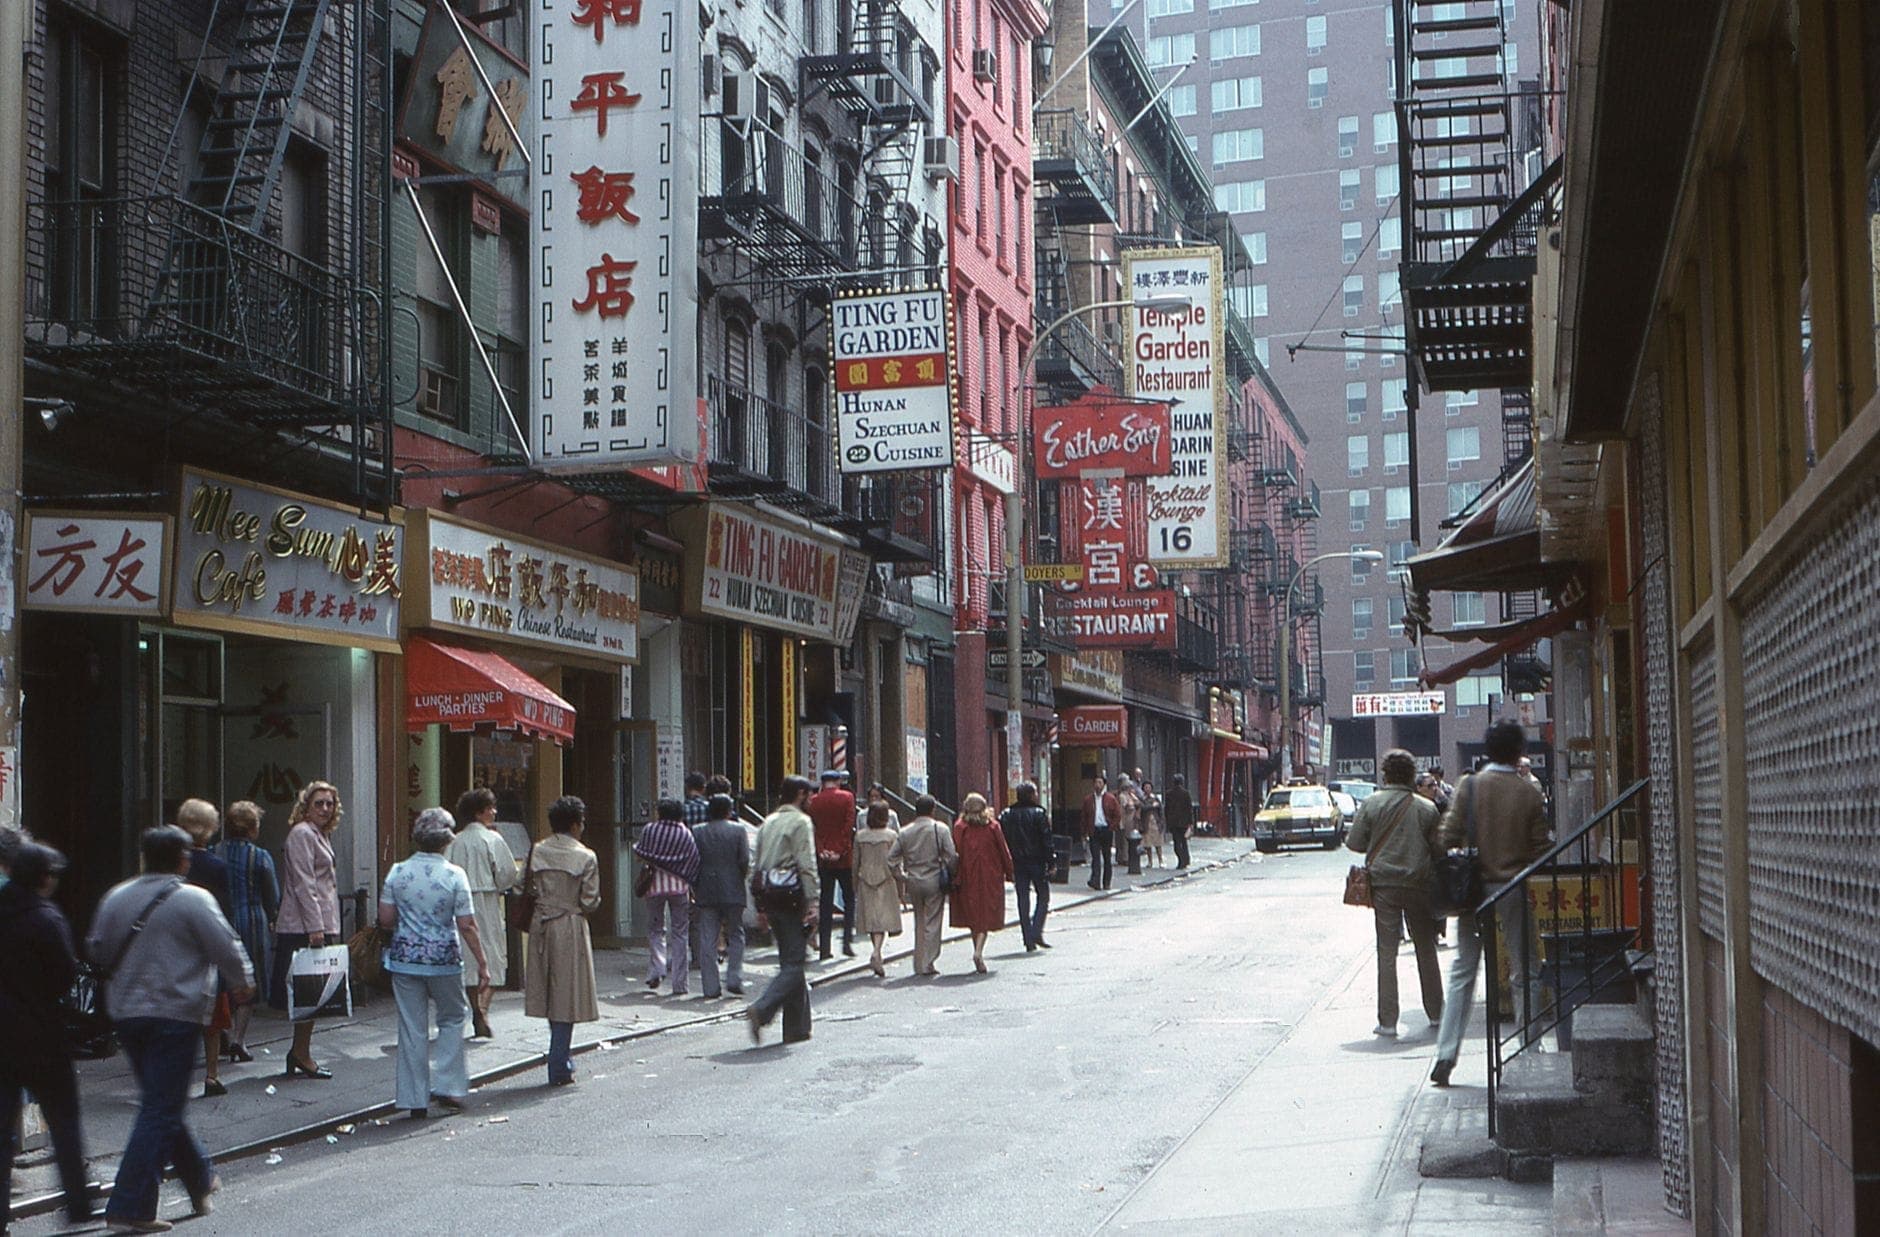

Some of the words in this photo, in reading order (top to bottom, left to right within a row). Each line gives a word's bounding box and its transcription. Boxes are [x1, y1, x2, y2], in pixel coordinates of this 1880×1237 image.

[837, 301, 898, 328] TING
[904, 298, 938, 321] FU
[839, 325, 940, 355] GARDEN
[1136, 331, 1211, 361] Garden
[1136, 364, 1212, 392] Restaurant
[1174, 413, 1213, 431] HUAN
[850, 449, 868, 460] 22
[1042, 419, 1122, 469] Esther
[1120, 413, 1161, 464] Eng
[1172, 459, 1208, 477] SINE
[189, 482, 261, 543] Mee
[265, 503, 335, 563] Sum
[1161, 526, 1192, 552] 16
[725, 515, 756, 579] TING
[758, 527, 776, 584] FU
[778, 534, 823, 598] GARDEN
[1024, 567, 1065, 580] DOYERS
[709, 576, 721, 599] 22
[819, 606, 829, 625] 22
[1112, 595, 1159, 611] Lounge
[451, 596, 475, 620] WO
[480, 602, 513, 629] PING
[517, 606, 551, 637] Chinese
[554, 614, 598, 645] Restaurant
[415, 694, 452, 707] LUNCH
[463, 691, 504, 706] DINNER
[439, 702, 486, 715] PARTIES
[524, 698, 538, 720] WO
[543, 706, 564, 728] PING
